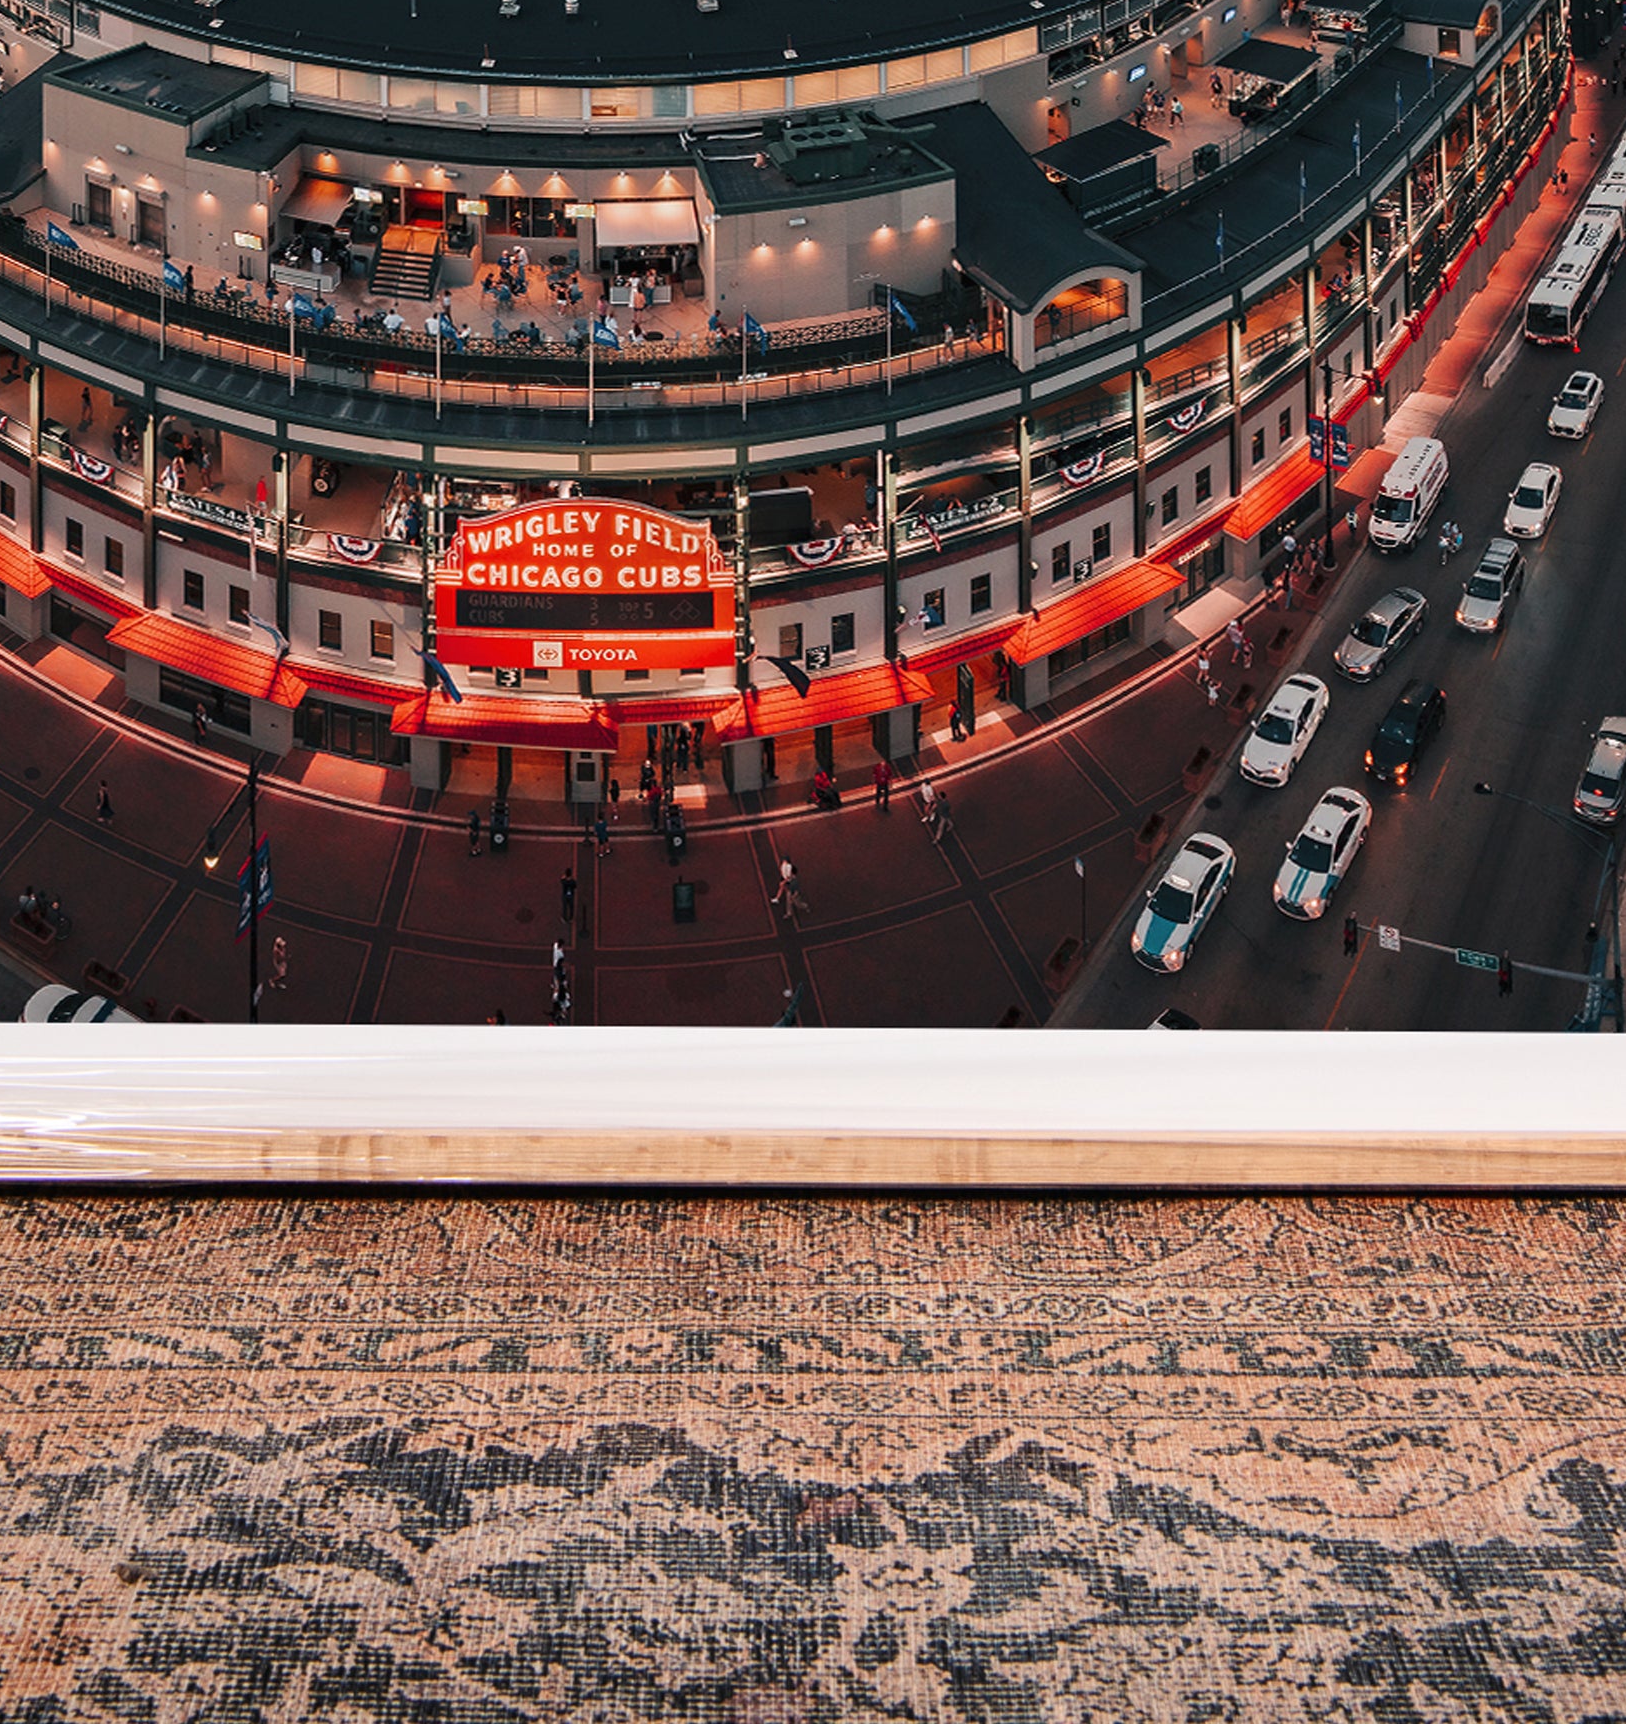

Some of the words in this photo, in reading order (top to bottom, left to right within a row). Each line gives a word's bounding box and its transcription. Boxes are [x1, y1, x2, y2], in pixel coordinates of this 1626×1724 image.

[468, 511, 602, 554] WRIGLEY
[615, 514, 702, 555] FIELD
[533, 543, 595, 557] HOME
[610, 543, 637, 557] OF
[467, 563, 603, 588] CHICAGO
[617, 564, 703, 588] CUBS
[569, 648, 638, 662] TOYOTA
